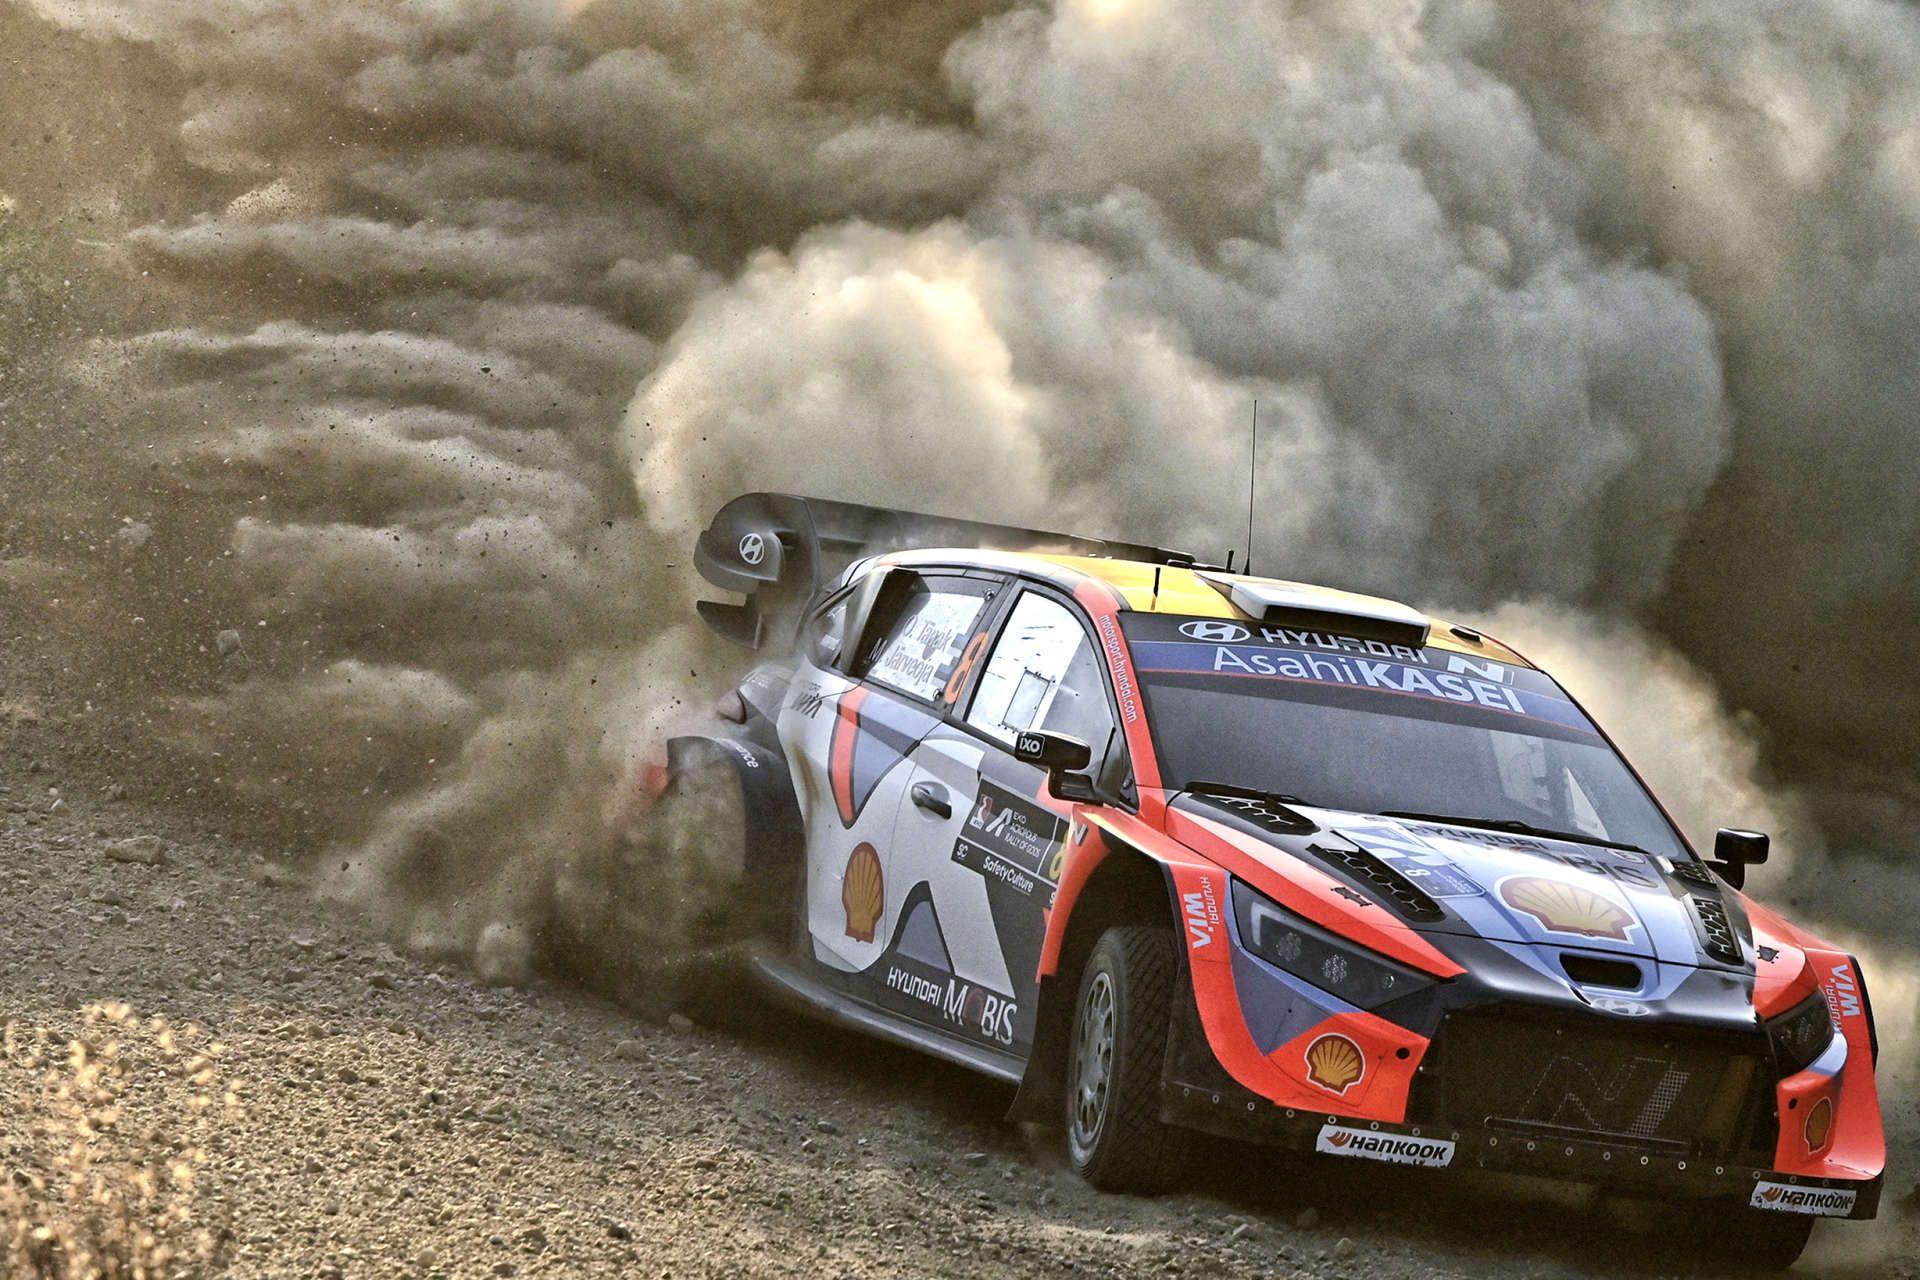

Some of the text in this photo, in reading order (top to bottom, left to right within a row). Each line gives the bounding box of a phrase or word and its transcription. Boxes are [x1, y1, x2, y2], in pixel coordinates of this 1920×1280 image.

[944, 630, 990, 705] 8
[1100, 614, 1138, 723] motorsport.hyundai.com
[1261, 627, 1429, 664] HYUNDAI
[982, 855, 1034, 893] SafetyCulture
[1183, 893, 1212, 950] WIA
[1200, 876, 1220, 925] HYUNDAI
[886, 966, 943, 1007] HYUNDAI
[1831, 964, 1861, 1017] WIA
